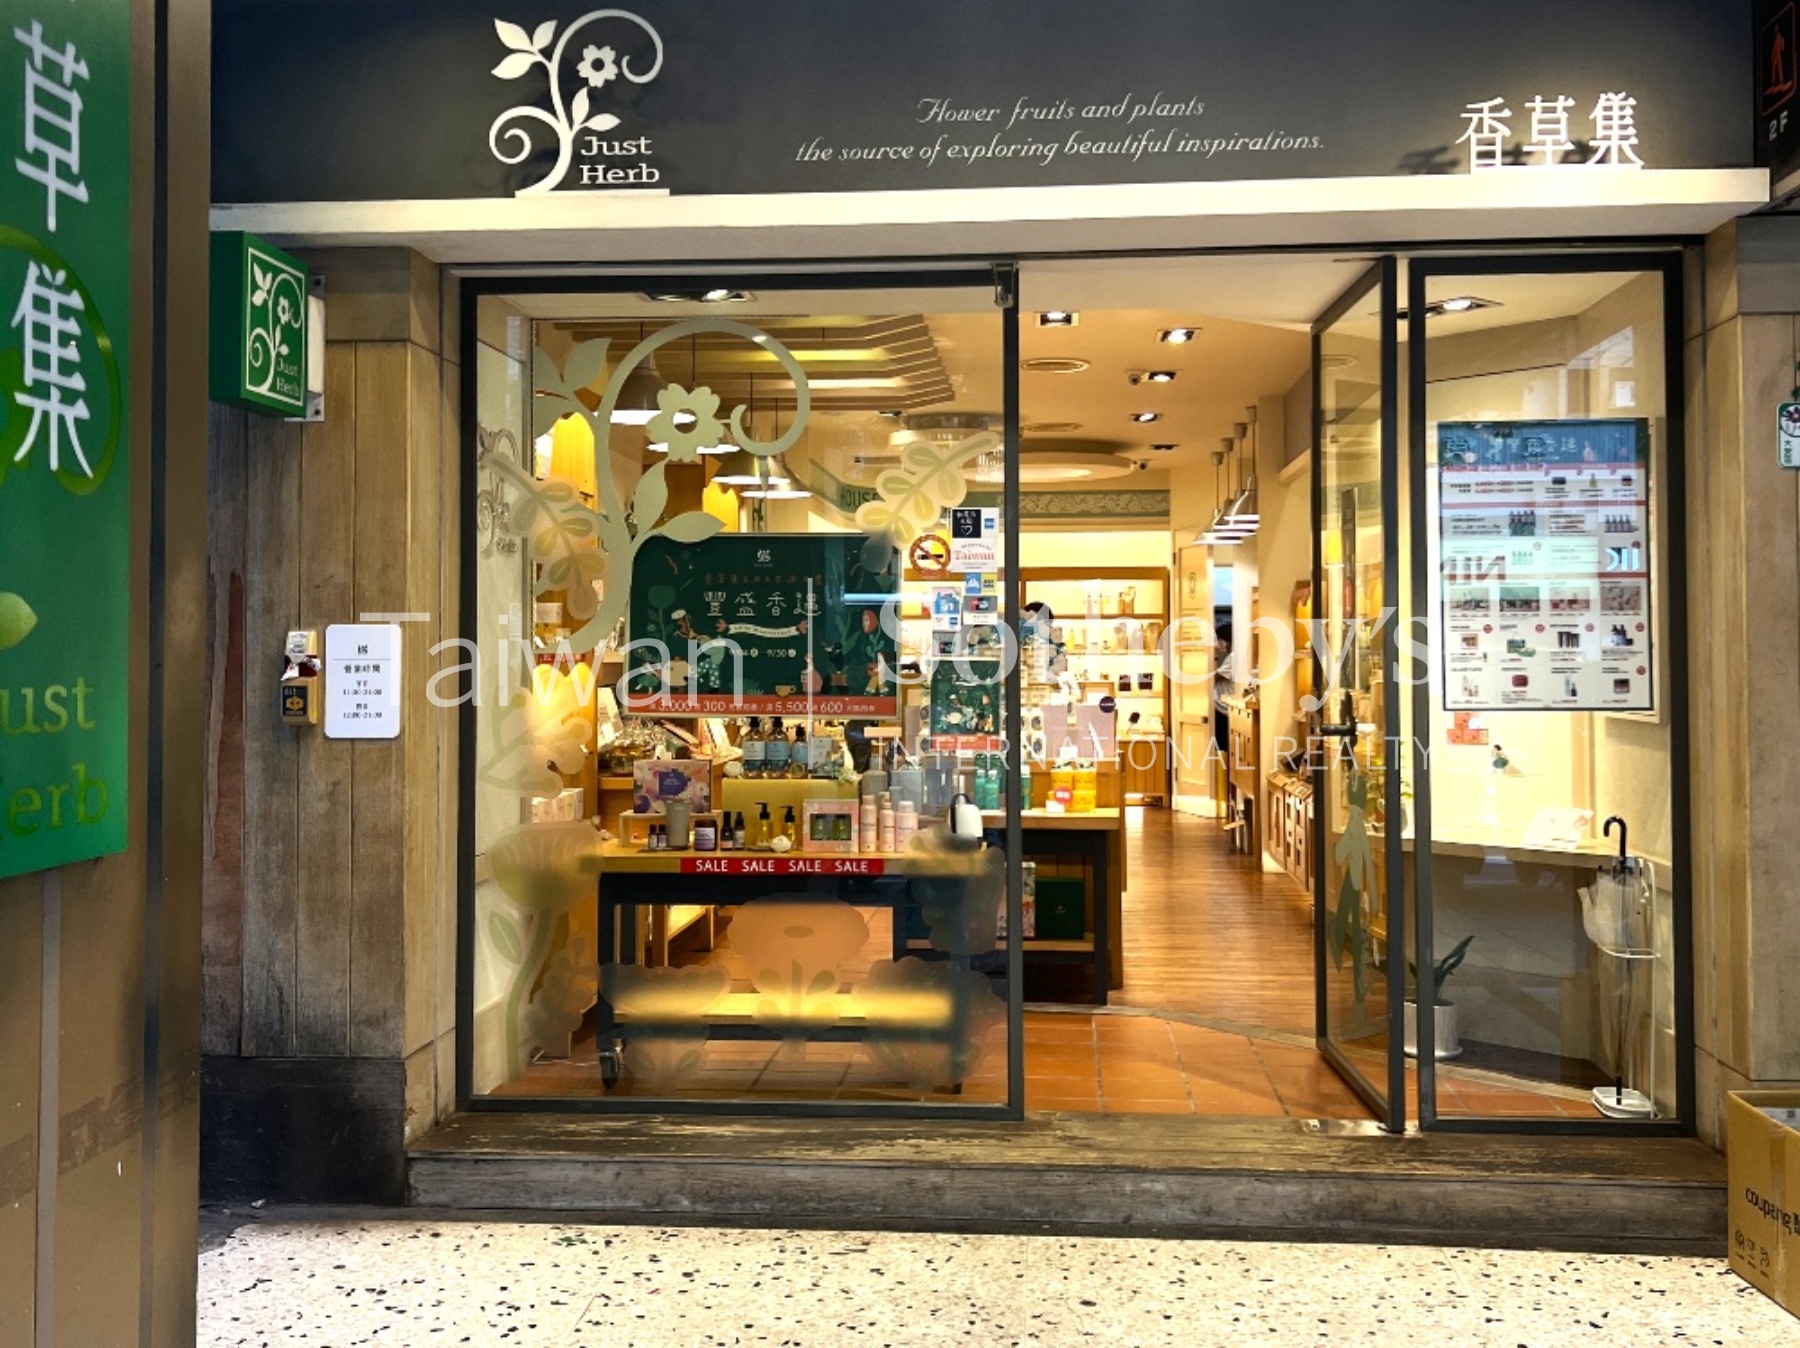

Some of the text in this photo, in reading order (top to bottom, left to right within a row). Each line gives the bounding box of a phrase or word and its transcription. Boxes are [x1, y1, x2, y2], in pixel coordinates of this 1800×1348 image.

[915, 91, 1206, 131] Flower fruits and plants
[1769, 109, 1788, 141] 2F
[580, 135, 653, 156] Just
[795, 128, 1325, 168] the source of exploring beautiful inspirations.
[1455, 91, 1645, 170] 香草集
[578, 162, 660, 184] Herb
[10, 17, 95, 478] 草集
[276, 357, 298, 377] Just
[0, 676, 96, 736] ust
[703, 700, 726, 712] 300
[820, 701, 843, 714] 600
[0, 762, 109, 841] erb
[695, 859, 869, 874] SALE SALE SALE SALE
